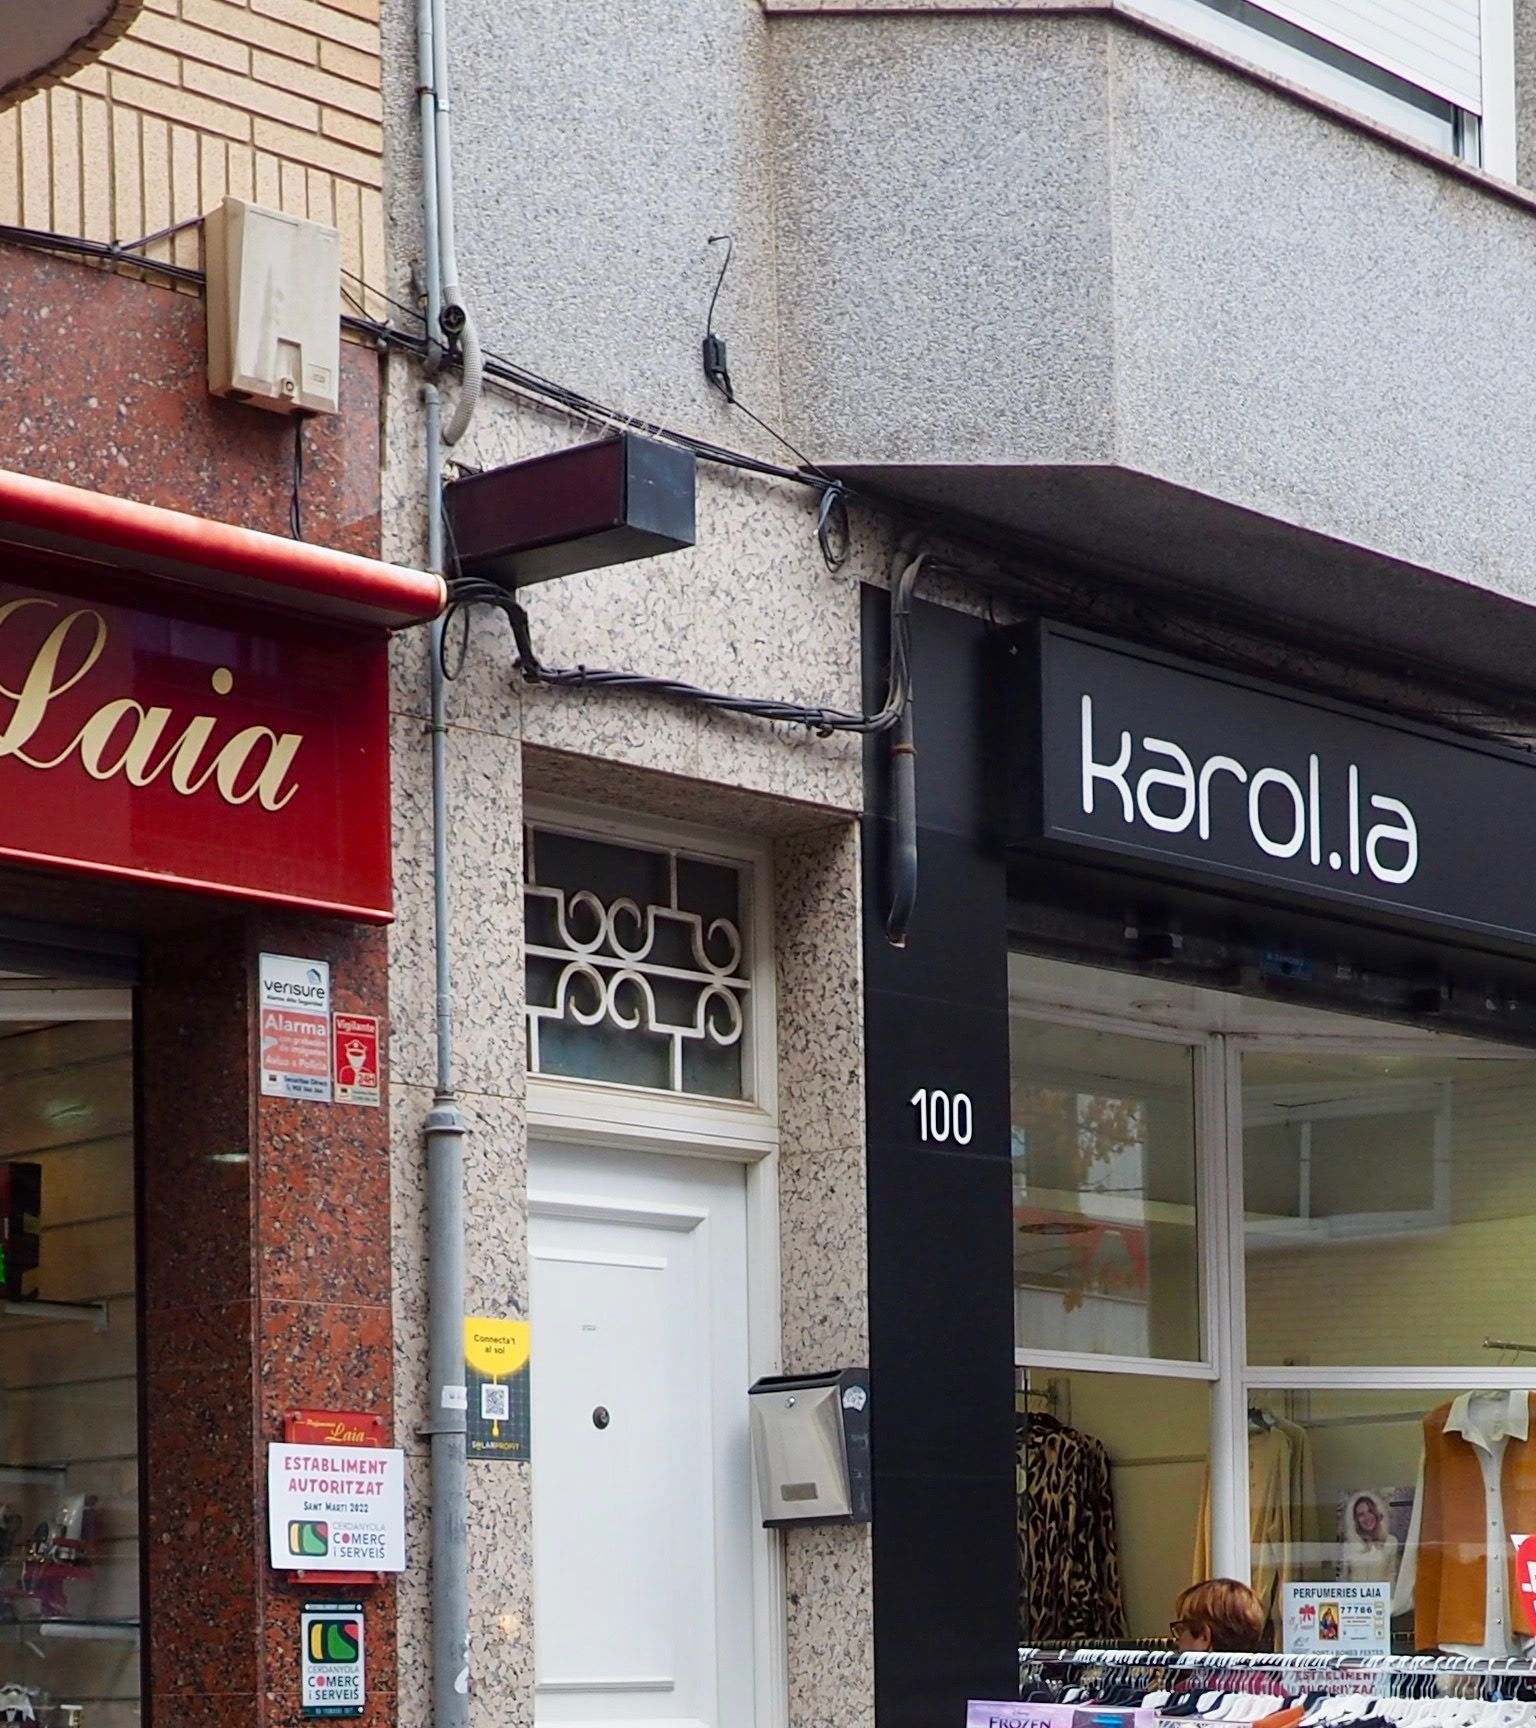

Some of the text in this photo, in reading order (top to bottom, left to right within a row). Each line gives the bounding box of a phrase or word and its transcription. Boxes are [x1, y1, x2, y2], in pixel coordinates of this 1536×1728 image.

[1082, 694, 1418, 884] karol.la
[265, 979, 325, 999] verisure
[265, 1014, 326, 1036] Alarma
[336, 1018, 376, 1034] Vigilante
[911, 1089, 972, 1145] 100
[325, 1422, 365, 1442] Laia
[284, 1456, 387, 1475] ESTABLIMENT
[288, 1478, 384, 1495] AUTORITZAT
[340, 1547, 385, 1558] SERVEIS
[1293, 1588, 1381, 1598] PERFUMERIES LAIA
[316, 1689, 360, 1700] SERVEIS
